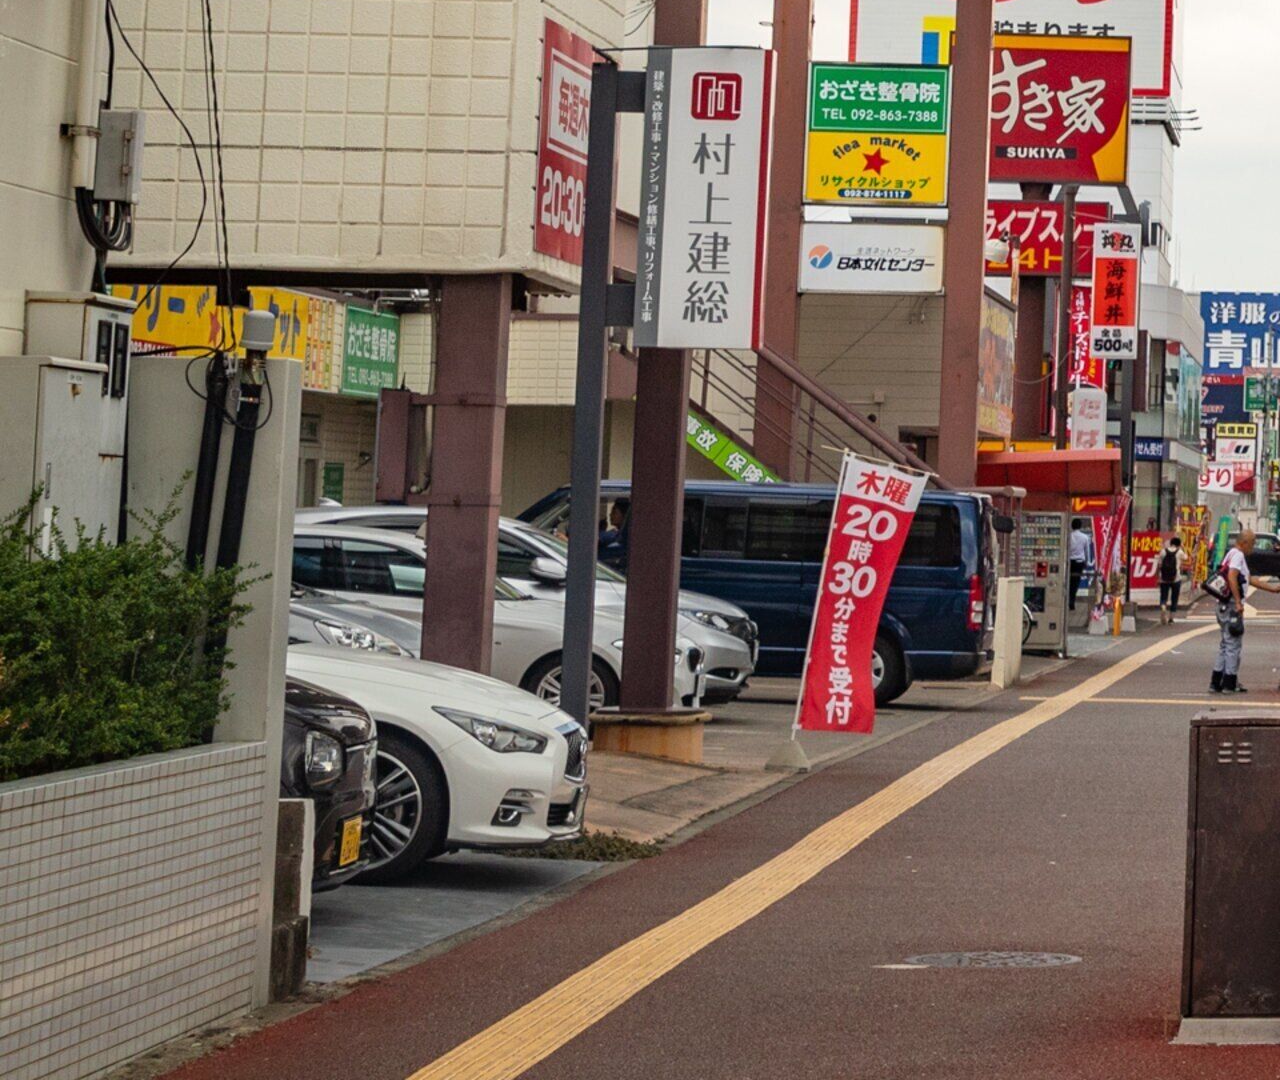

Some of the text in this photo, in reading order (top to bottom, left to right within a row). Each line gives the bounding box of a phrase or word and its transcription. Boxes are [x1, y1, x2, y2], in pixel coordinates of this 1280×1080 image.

[819, 80, 941, 103] おざき整骨院
[822, 107, 938, 122] TEL 092-863-7388
[832, 136, 921, 162] flea market
[1006, 147, 1066, 160] SUKIYA
[820, 174, 931, 189] リサイクルショップ
[682, 132, 736, 324] 村上建総
[836, 257, 936, 272] 日本文化センター
[1104, 260, 1126, 324] 海鮮丼
[856, 470, 914, 507] 木曜
